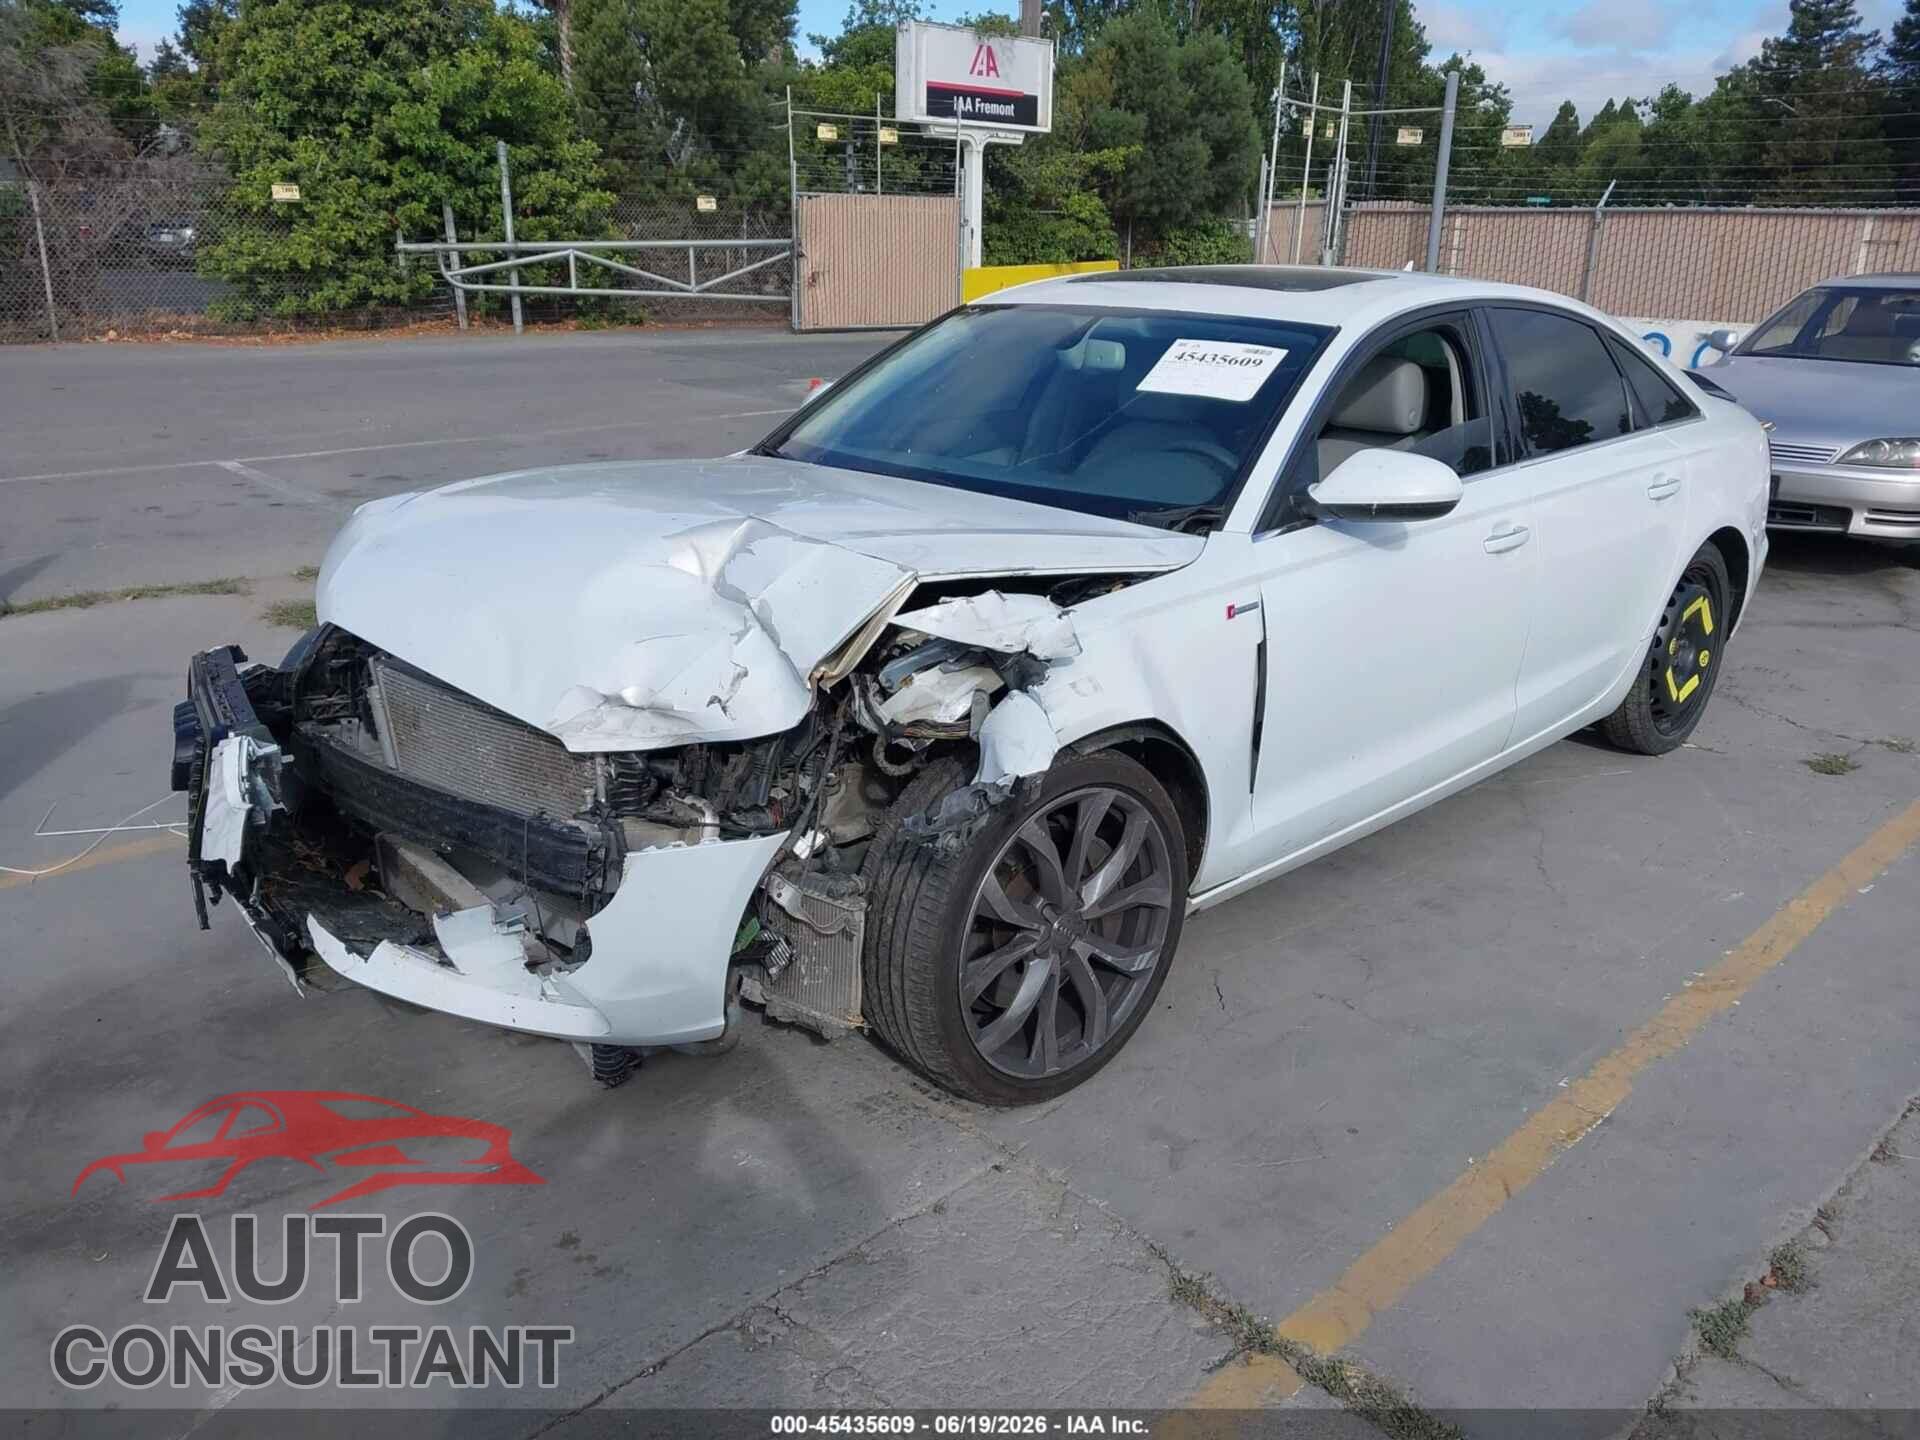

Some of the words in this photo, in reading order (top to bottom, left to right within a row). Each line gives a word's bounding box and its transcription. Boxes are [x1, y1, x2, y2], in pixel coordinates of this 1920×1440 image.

[953, 95, 973, 112] IAA
[975, 97, 1015, 117] Fremont
[1174, 351, 1264, 368] 45435609
